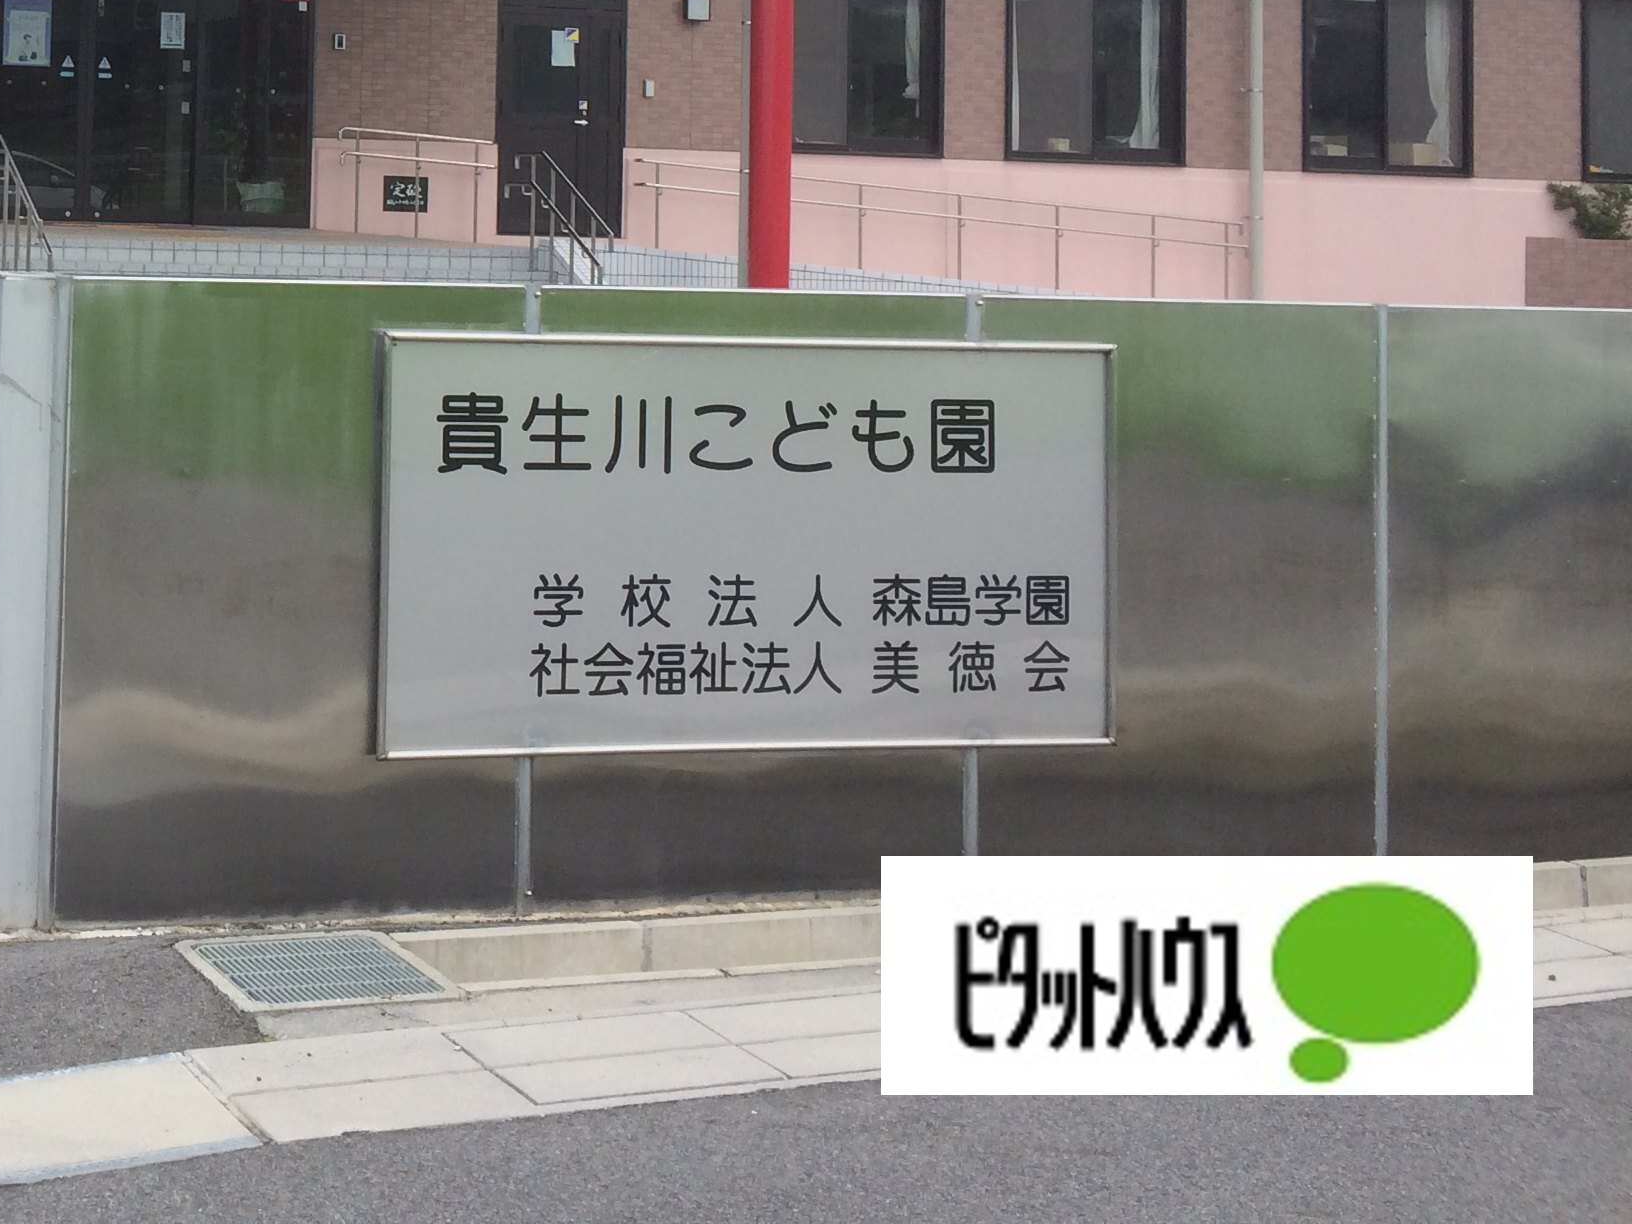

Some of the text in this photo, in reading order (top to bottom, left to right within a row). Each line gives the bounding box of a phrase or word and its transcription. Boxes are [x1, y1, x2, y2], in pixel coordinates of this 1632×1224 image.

[436, 392, 995, 475] 貴生川こども園
[533, 573, 1070, 628] 学校法人 森島学園
[529, 641, 842, 697] 社会福祉法人
